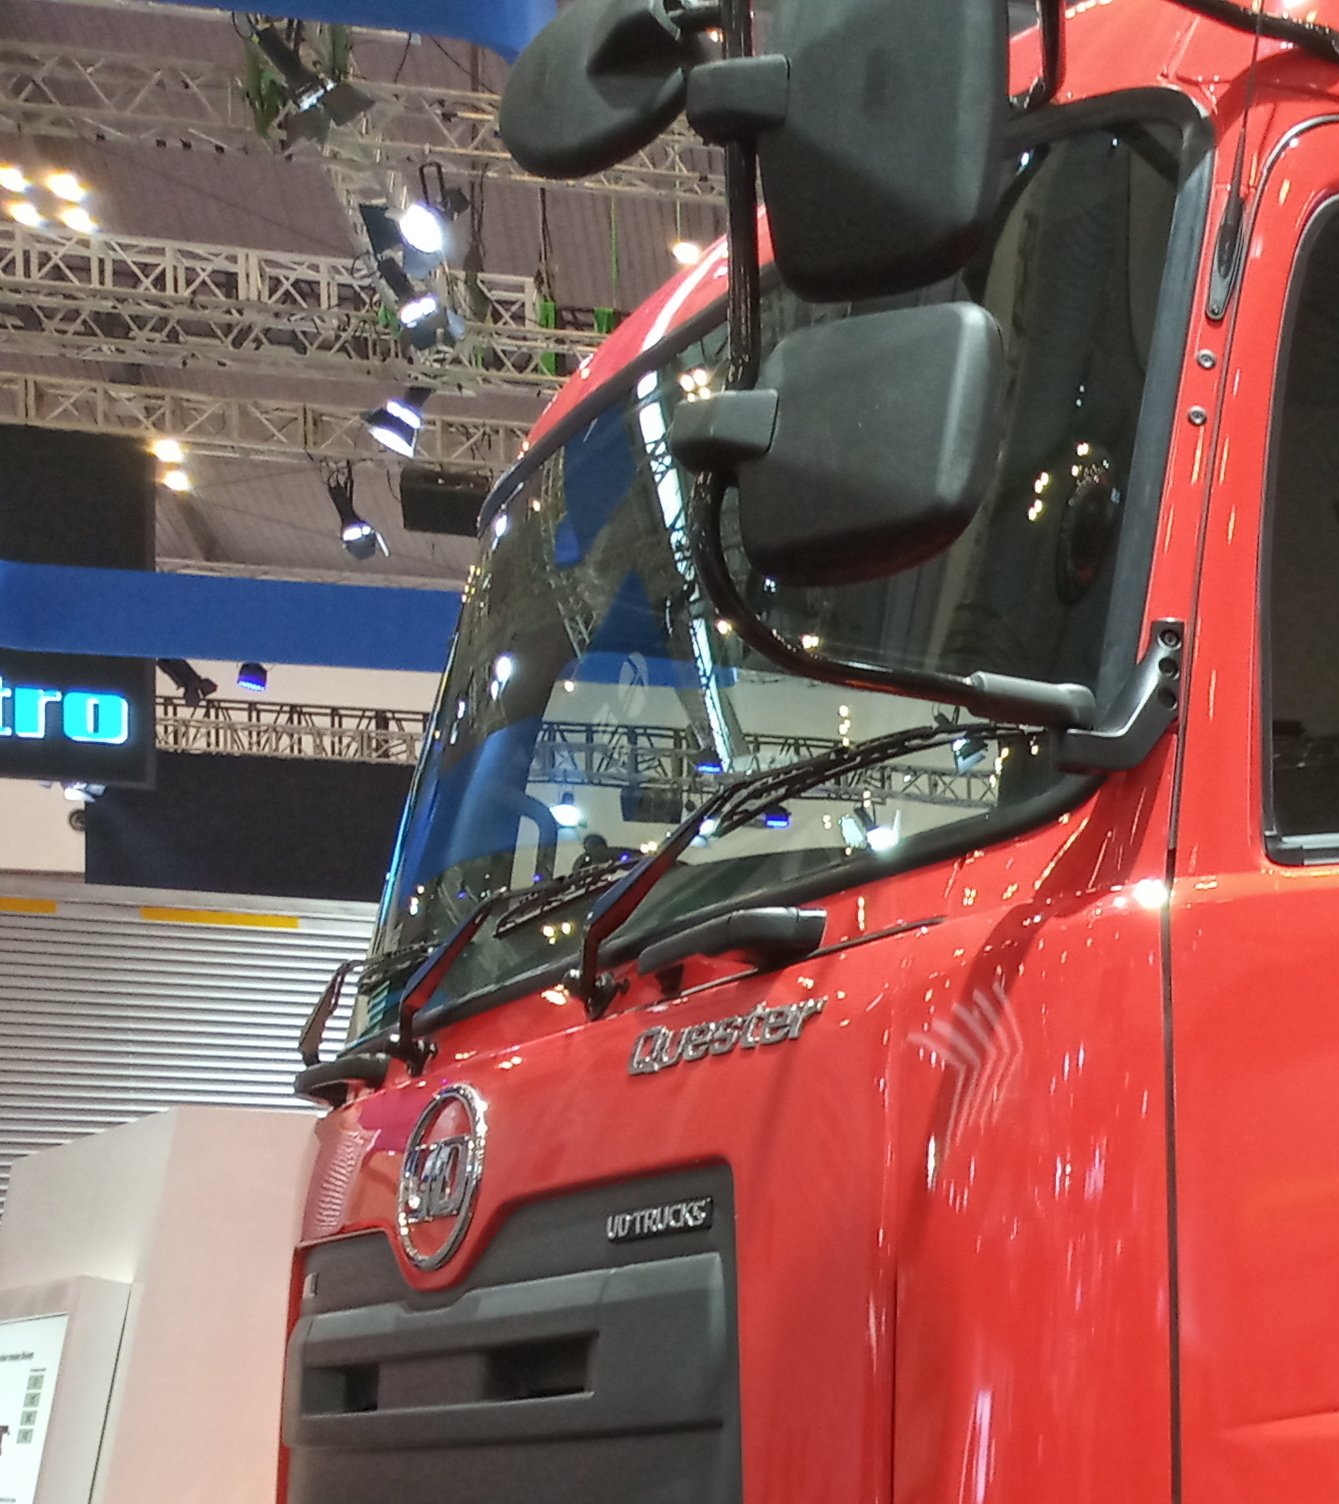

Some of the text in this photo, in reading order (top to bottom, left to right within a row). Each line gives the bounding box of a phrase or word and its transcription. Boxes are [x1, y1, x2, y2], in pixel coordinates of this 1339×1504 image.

[628, 995, 828, 1076] Quester
[605, 1201, 708, 1240] UD TRUCKS
